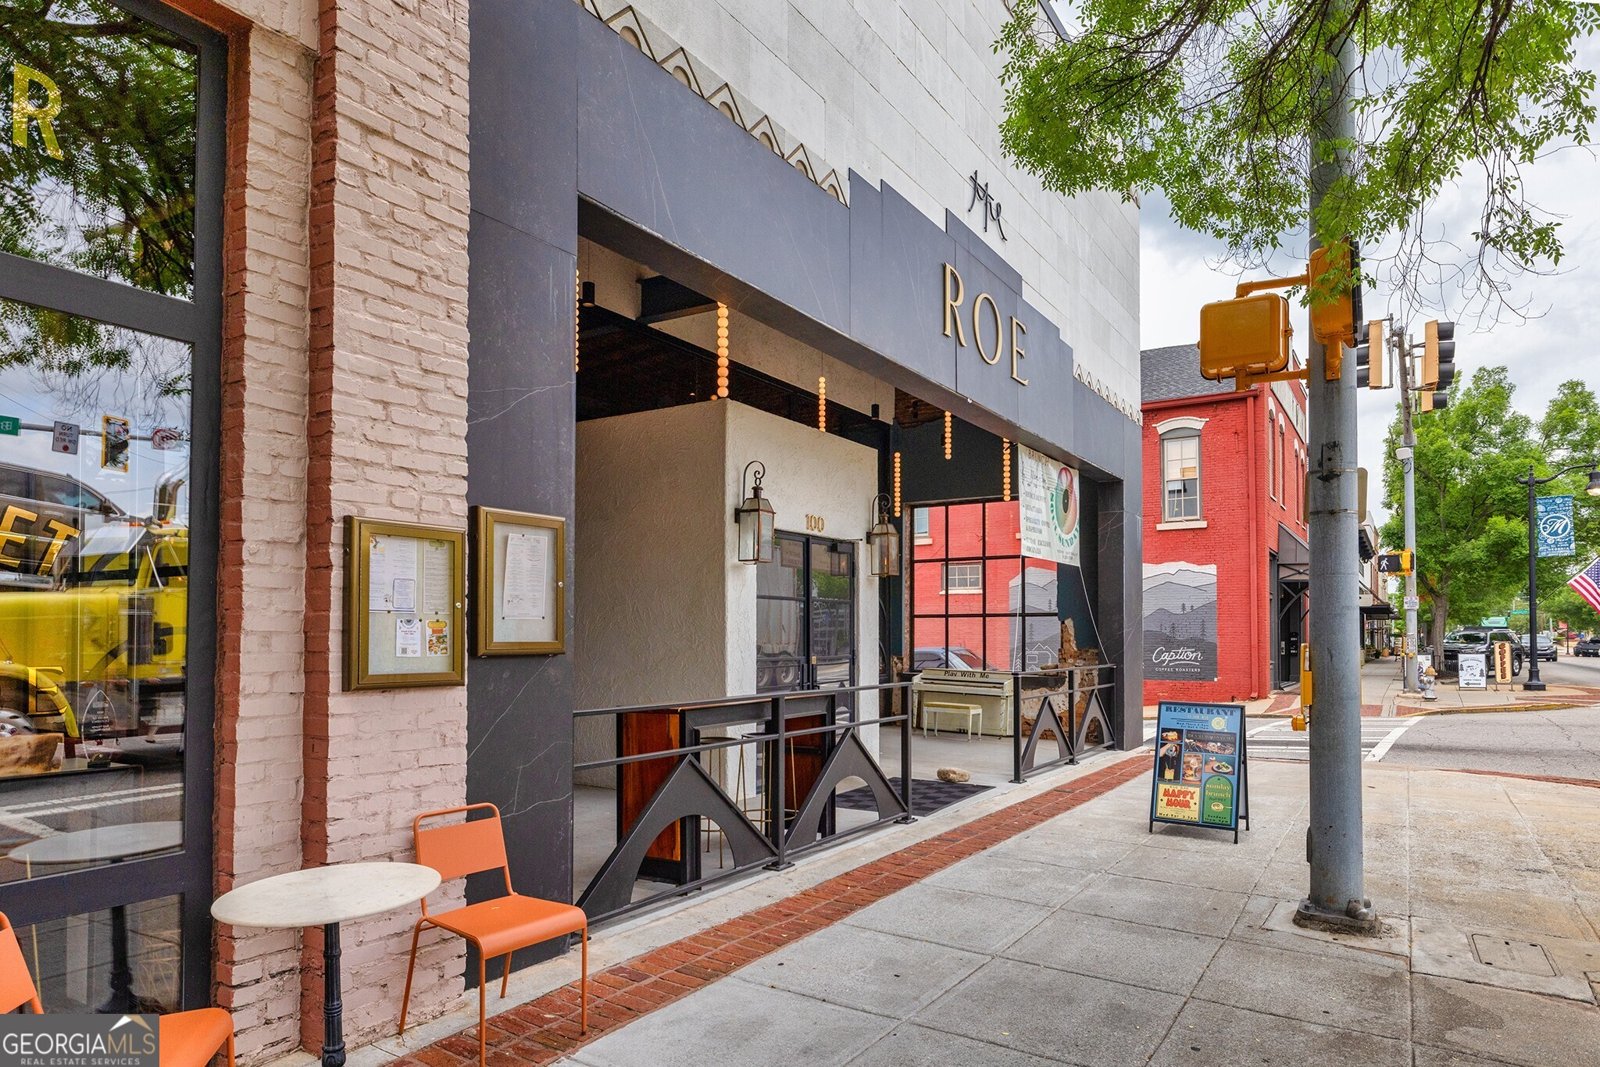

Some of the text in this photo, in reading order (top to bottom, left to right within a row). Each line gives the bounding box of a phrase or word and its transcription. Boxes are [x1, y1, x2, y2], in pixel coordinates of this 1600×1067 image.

[942, 261, 1030, 387] ROE
[804, 513, 825, 533] 100
[1152, 646, 1204, 667] Caption
[1165, 705, 1236, 716] RESTAURANT
[1163, 788, 1196, 800] HAPPY
[1166, 797, 1191, 809] HOUR
